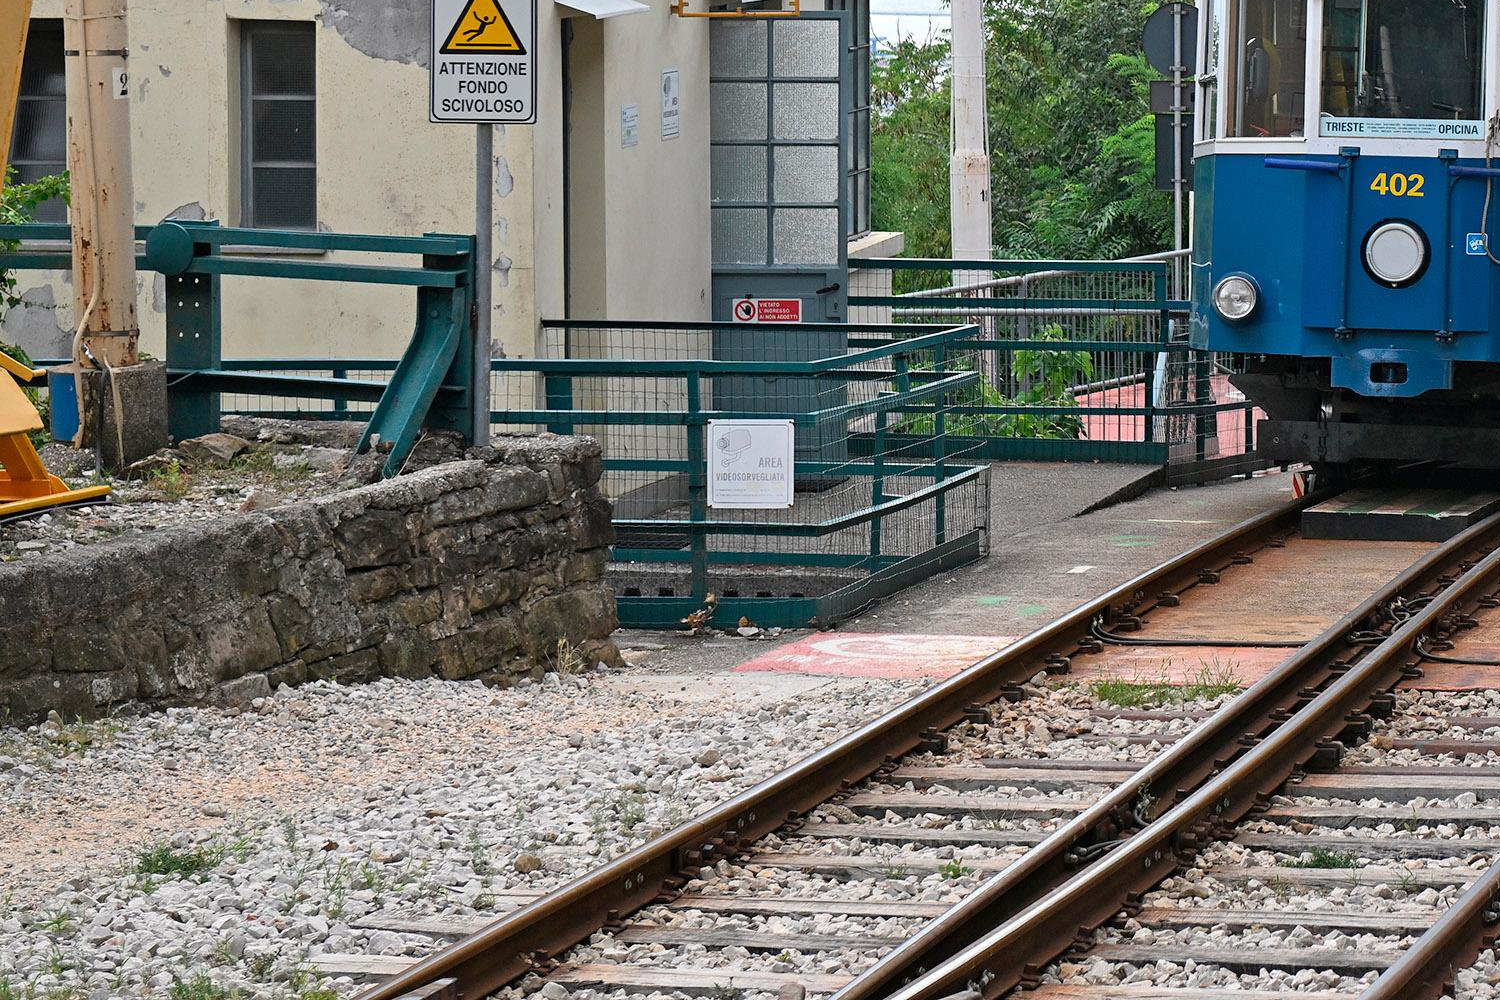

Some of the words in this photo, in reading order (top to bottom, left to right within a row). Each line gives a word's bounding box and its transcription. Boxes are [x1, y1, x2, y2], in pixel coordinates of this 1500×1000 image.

[439, 62, 527, 76] ATTENZIONE
[458, 80, 508, 94] FONDO
[441, 98, 524, 113] SCIVOLOSO
[1325, 121, 1365, 133] TRIESTE
[1438, 124, 1479, 135] OPICINA
[1370, 172, 1425, 197] 402
[758, 457, 783, 468] AREA
[715, 472, 785, 481] VIDEOSORVEGLIATA
